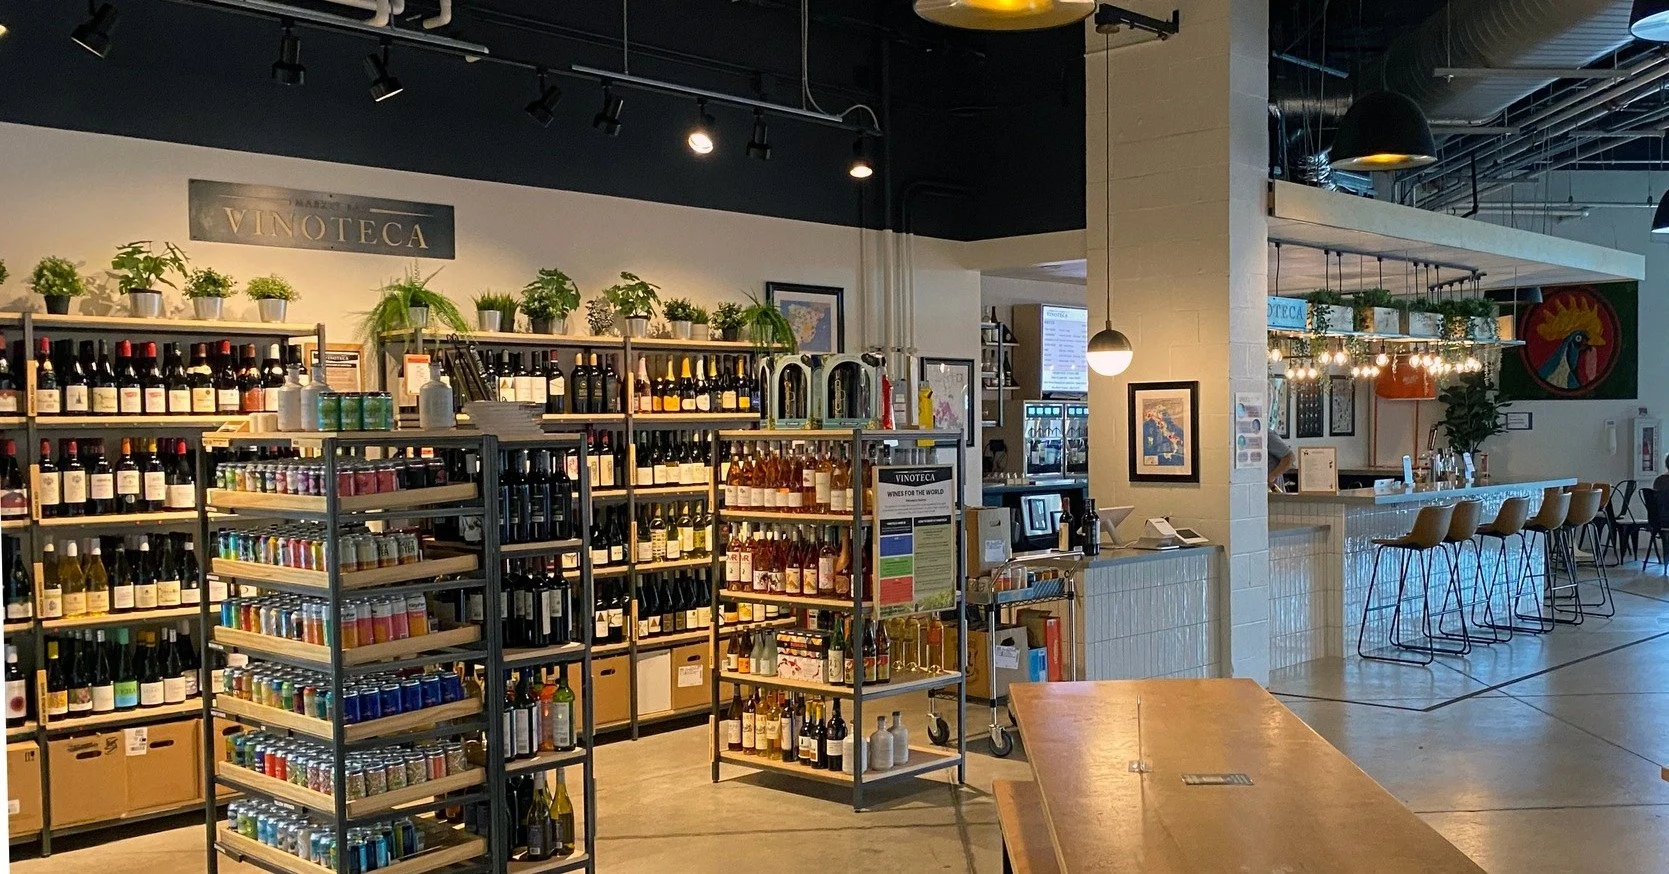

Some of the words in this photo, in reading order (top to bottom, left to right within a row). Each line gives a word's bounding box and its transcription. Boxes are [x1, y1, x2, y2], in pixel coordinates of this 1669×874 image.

[223, 207, 429, 249] VINOTECA
[895, 473, 936, 482] VINOTECA
[887, 490, 905, 498] WINES
